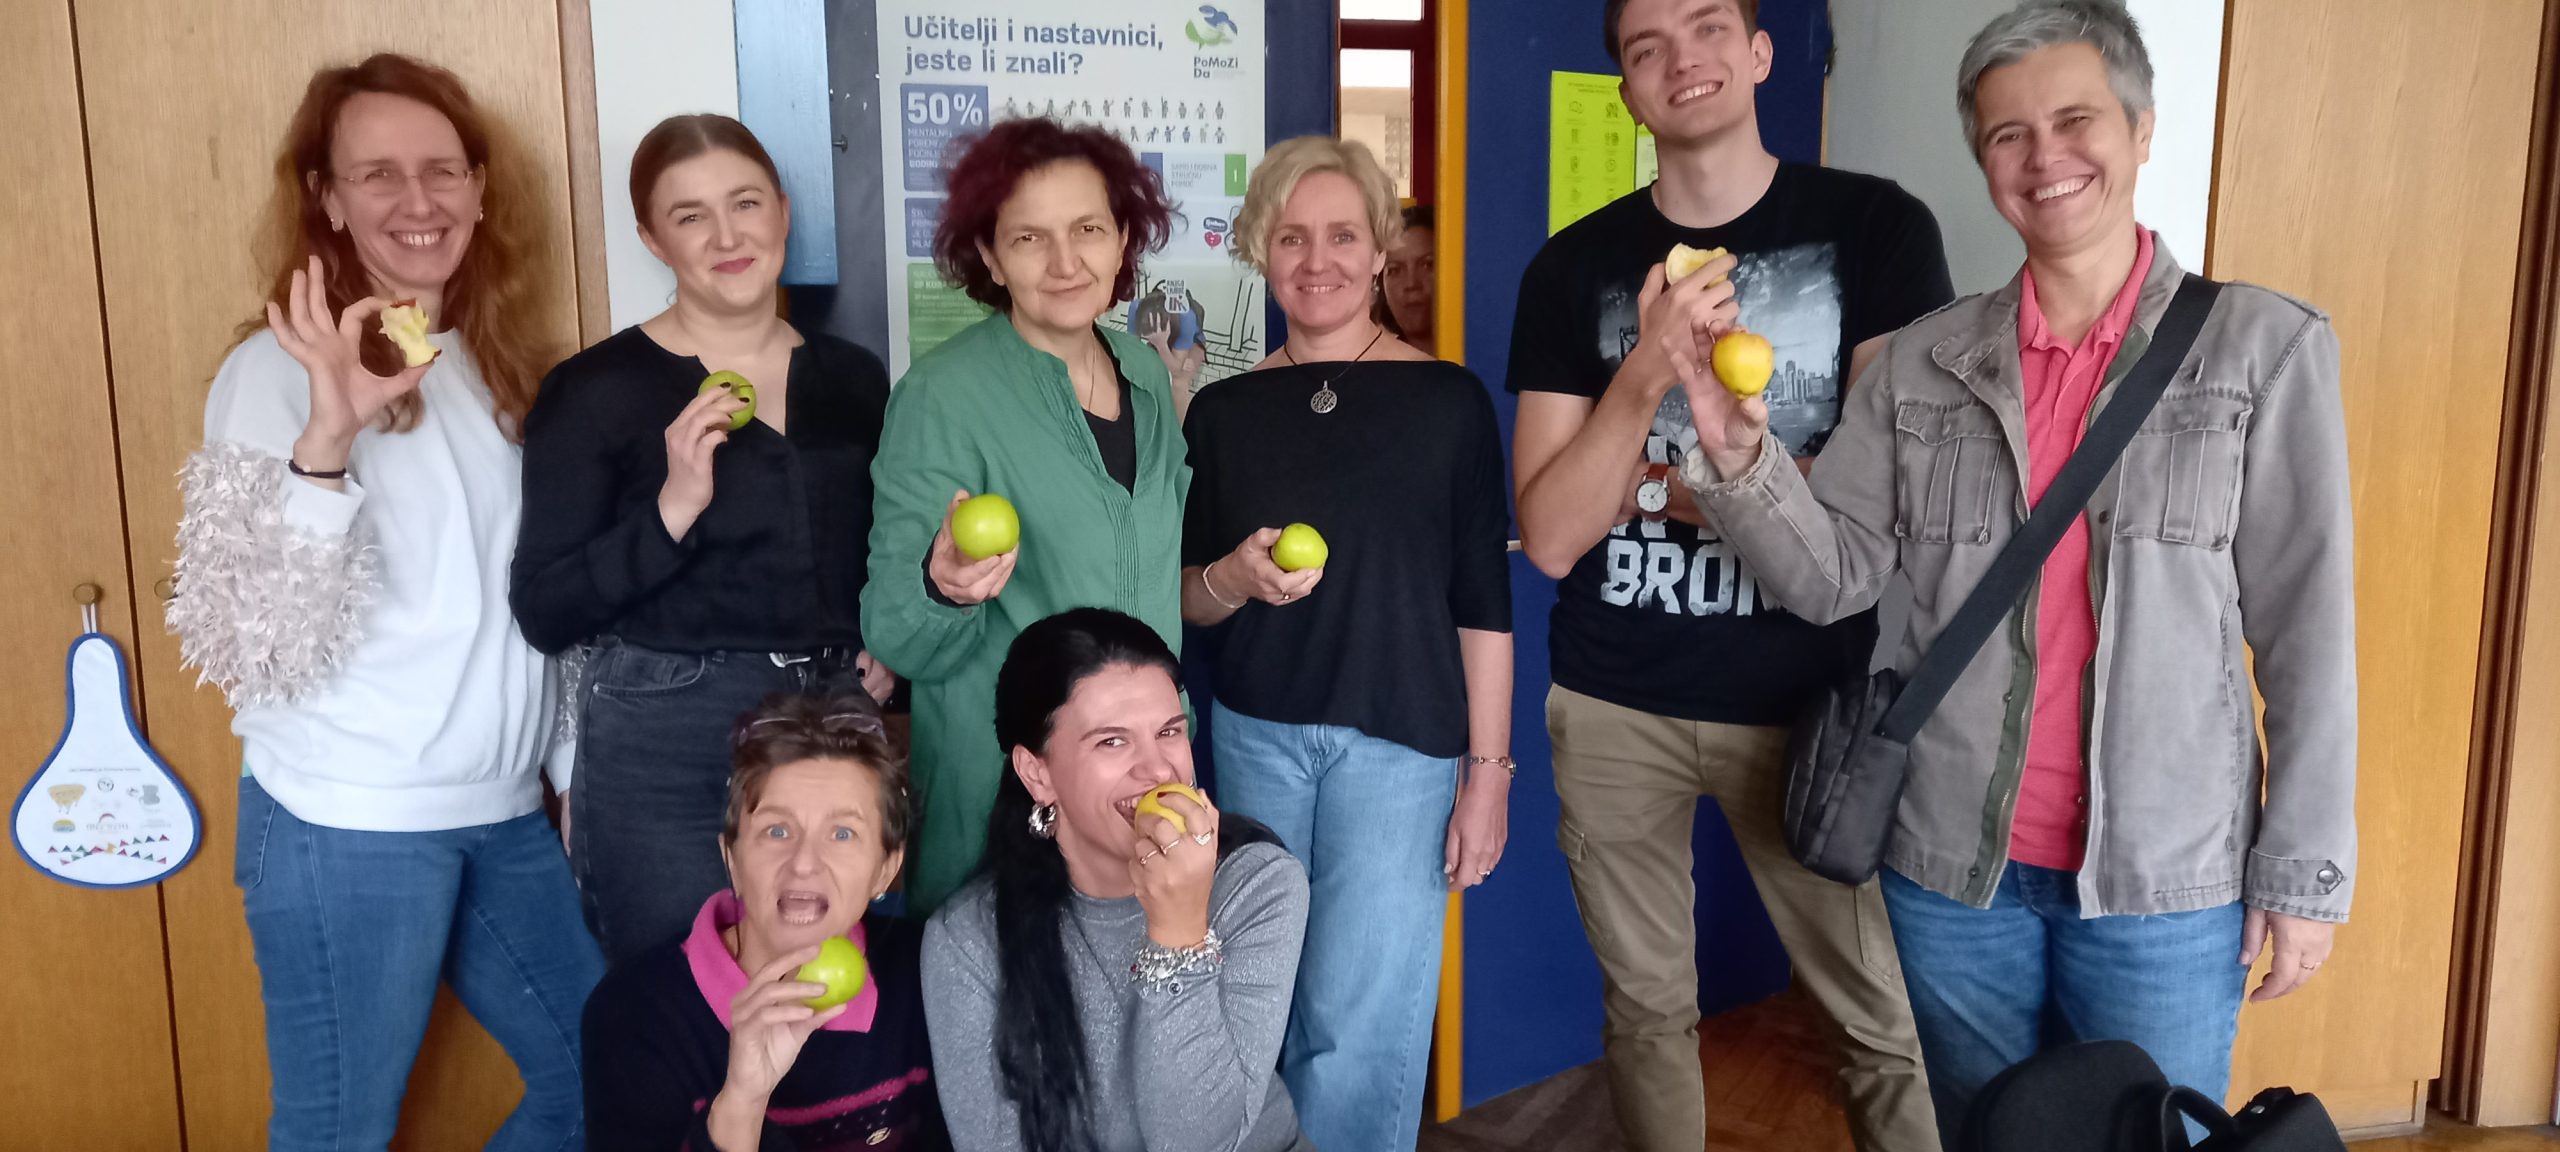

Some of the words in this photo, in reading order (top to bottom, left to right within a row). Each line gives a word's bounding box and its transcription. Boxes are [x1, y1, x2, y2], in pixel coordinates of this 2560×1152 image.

[904, 15, 997, 47] Učitelji
[1008, 19, 1014, 42] i
[1023, 23, 1163, 50] nastavnici,
[905, 47, 972, 75] jeste
[982, 47, 995, 72] li
[1005, 52, 1083, 74] znali?
[907, 92, 983, 126] 50%
